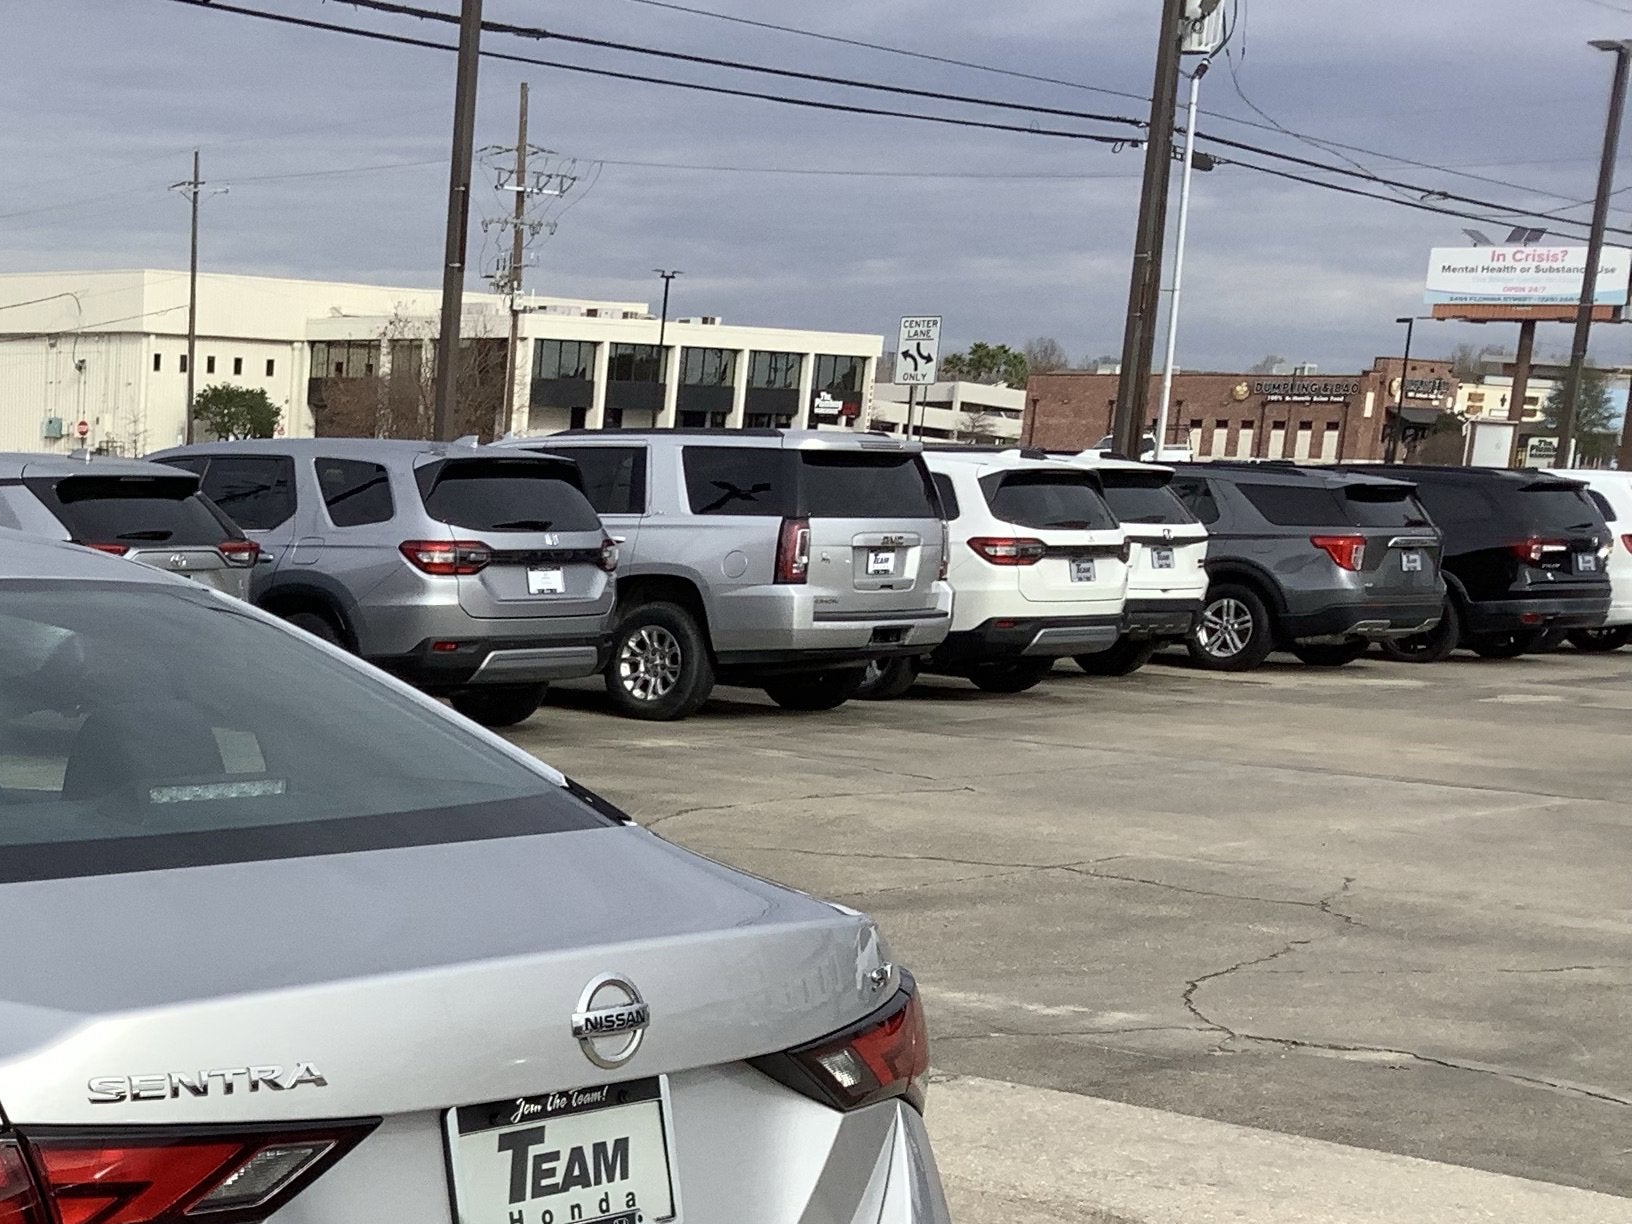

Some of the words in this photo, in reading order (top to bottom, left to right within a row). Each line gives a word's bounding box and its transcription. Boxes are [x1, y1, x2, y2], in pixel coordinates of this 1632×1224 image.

[1491, 250, 1506, 262] In
[1512, 249, 1568, 263] Crisis?
[1441, 264, 1478, 274] Mental
[1480, 264, 1517, 274] Health
[1519, 265, 1531, 274] or
[1533, 264, 1588, 274] Substanc
[903, 320, 938, 329] CENTER
[907, 329, 932, 338] LANE
[902, 372, 927, 381] ONLY
[584, 1009, 646, 1031] NISSAN
[88, 1062, 328, 1104] SENTRA
[510, 1098, 542, 1123] Join
[568, 1086, 609, 1108] Team!
[497, 1125, 630, 1205] TEAM
